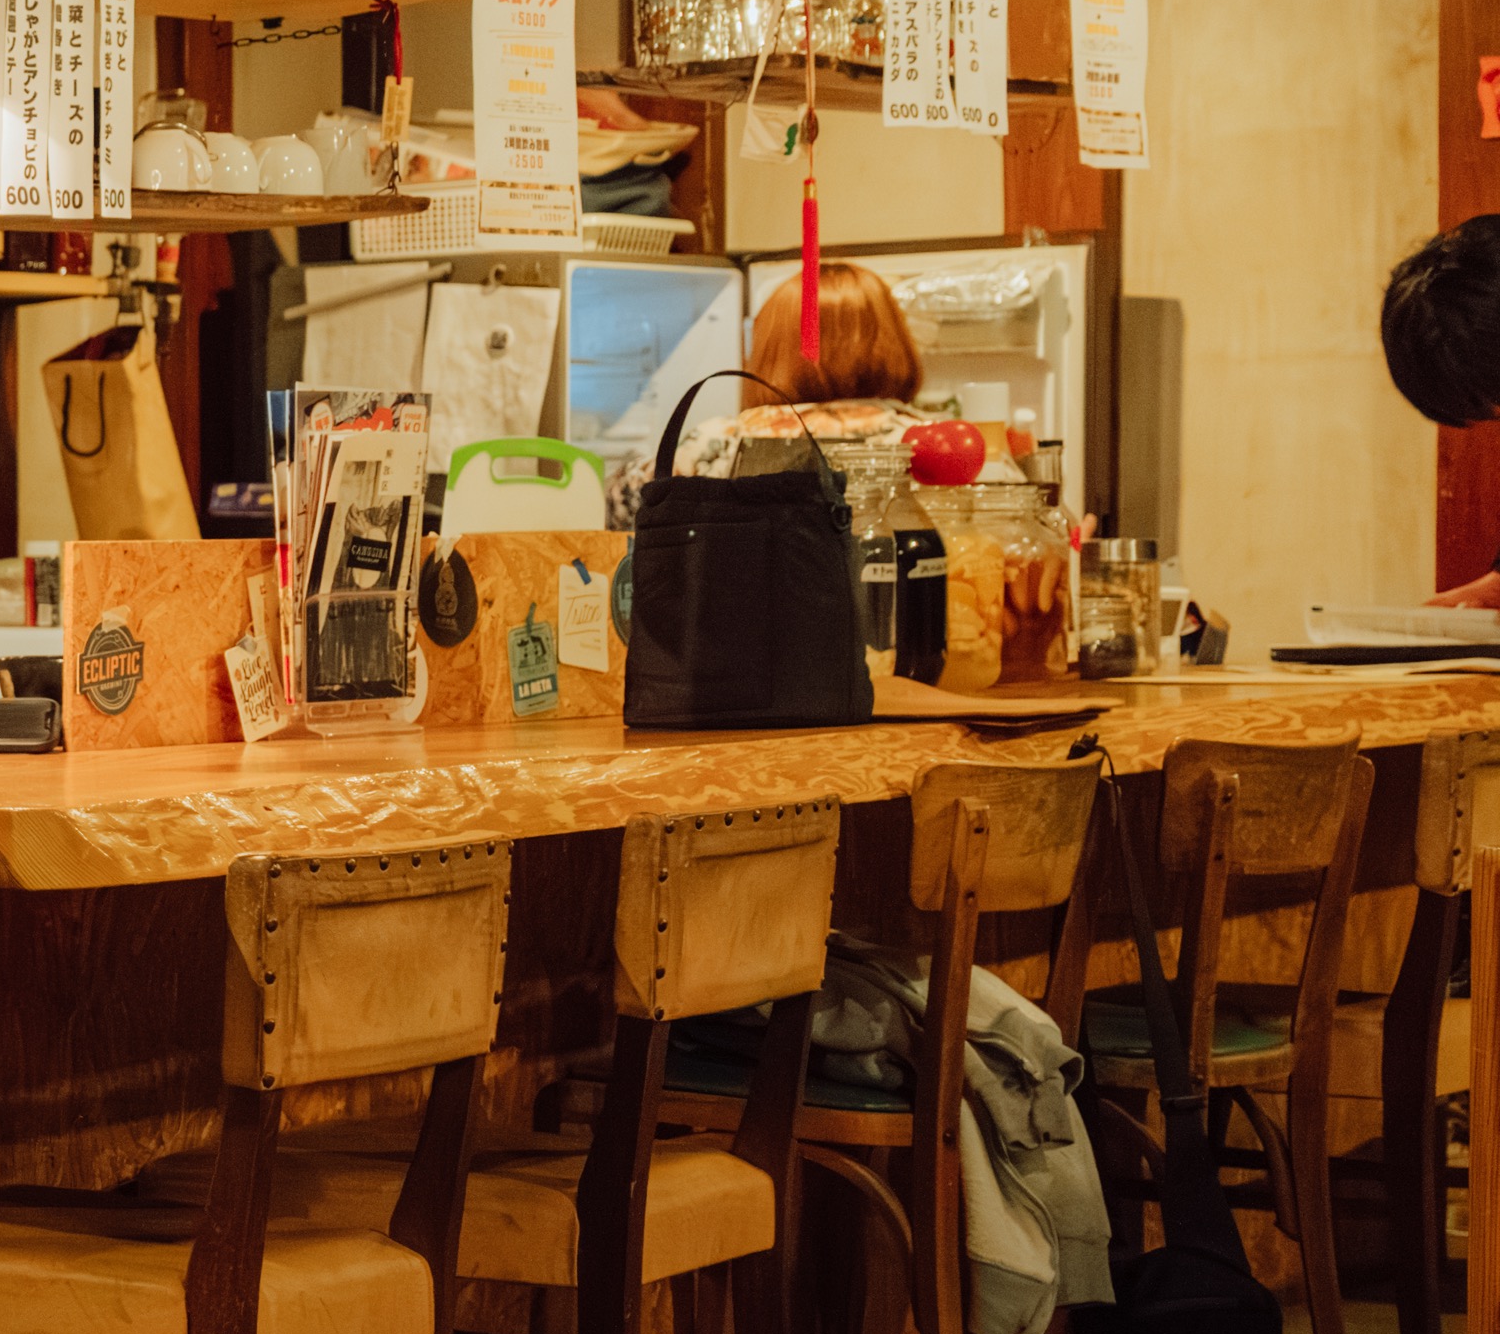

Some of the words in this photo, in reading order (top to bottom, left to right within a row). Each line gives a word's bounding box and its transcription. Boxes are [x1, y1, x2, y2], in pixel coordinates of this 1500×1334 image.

[890, 103, 919, 119] 600
[6, 185, 41, 206] 600
[55, 189, 84, 210] 600
[104, 188, 125, 210] 600
[83, 651, 140, 684] ECLIPTIC
